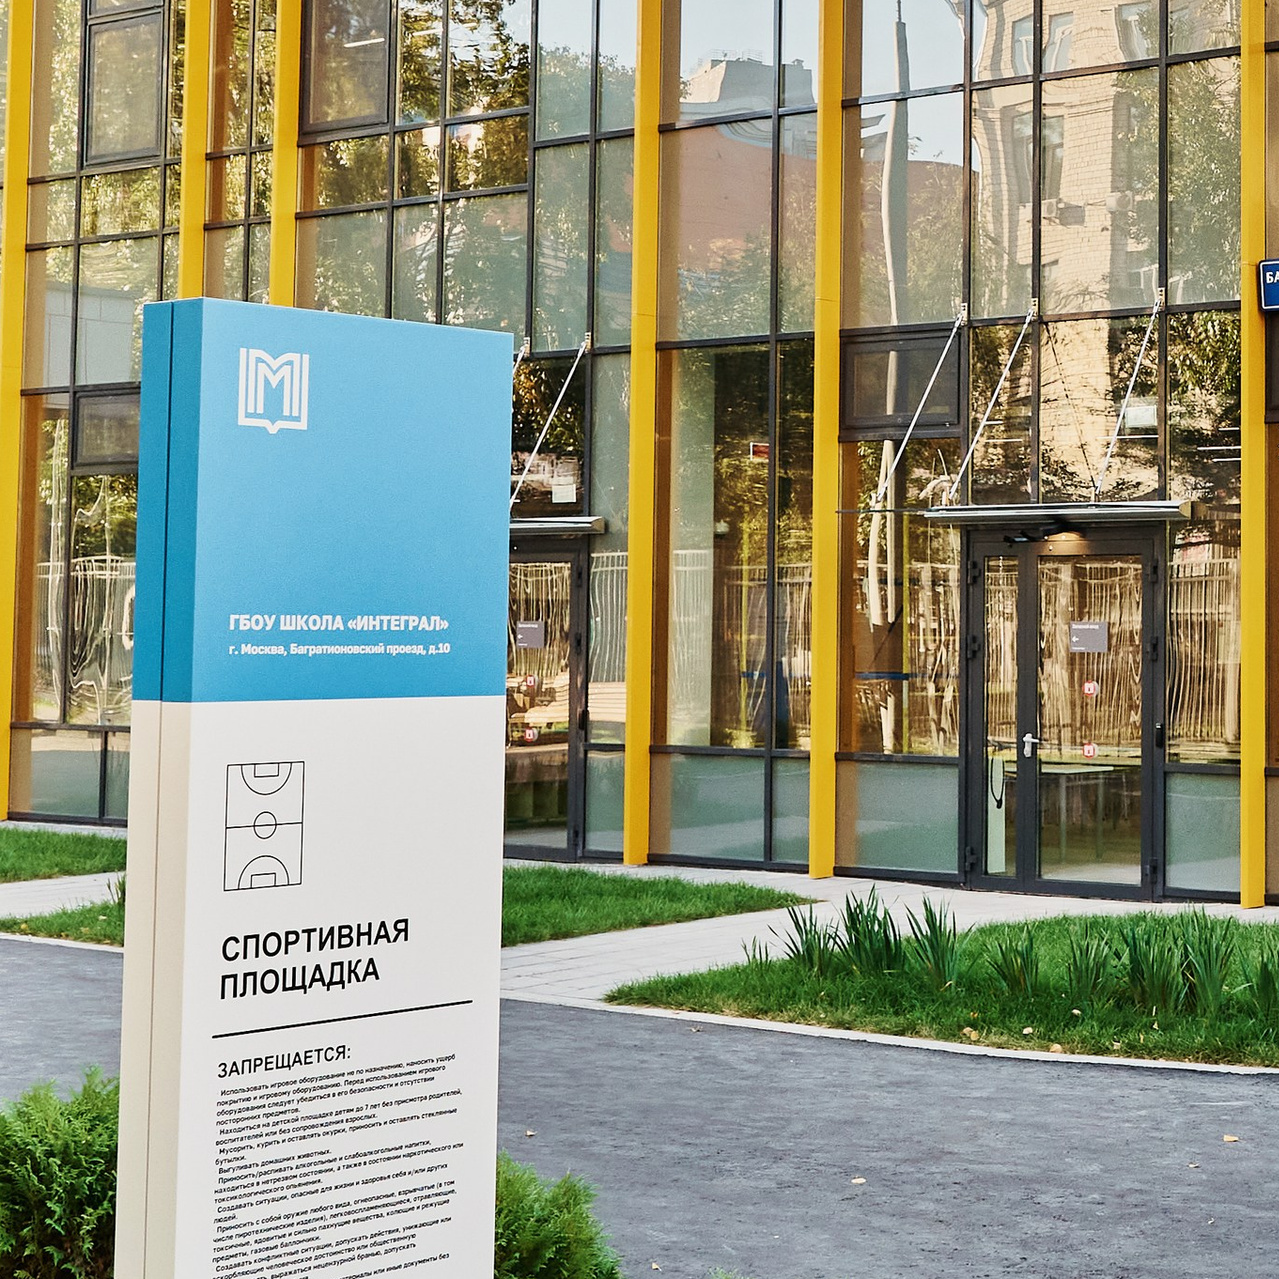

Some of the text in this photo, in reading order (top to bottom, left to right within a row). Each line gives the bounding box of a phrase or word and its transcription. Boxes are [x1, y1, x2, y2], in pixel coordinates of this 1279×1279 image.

[229, 614, 449, 631] ГБОУ ШКОЛА «ИНТЕГРАЛ»
[228, 643, 450, 657] г. Москва, Багратионовский проезд, д.10
[221, 917, 410, 962] СПОРТИВНАЯ
[220, 956, 380, 1000] ПЛОЩАДКА
[217, 1044, 351, 1079] ЗАПРЕЩАЕТСЯ:
[221, 1085, 269, 1096] Использовать
[270, 1080, 297, 1088] игровое
[299, 1072, 345, 1084] оборудование
[436, 1054, 455, 1063] ущерб
[217, 1097, 251, 1106] покрытию
[259, 1091, 291, 1100] игровому
[419, 1066, 445, 1074] игрового
[217, 1104, 266, 1116] оборудования
[268, 1099, 294, 1108] следует
[297, 1093, 330, 1105] убедиться
[349, 1084, 393, 1094] безопасности
[400, 1077, 434, 1086] отсутствии
[216, 1114, 260, 1125] посторонних
[220, 1124, 260, 1135] Находиться
[272, 1116, 299, 1127] детской
[300, 1112, 333, 1121] площадке
[335, 1108, 354, 1116] детям
[394, 1096, 427, 1106] присмотра
[257, 1140, 280, 1148] курить
[287, 1133, 321, 1142] оставлять
[349, 1122, 382, 1132] приносить
[389, 1115, 420, 1124] оставлять
[422, 1108, 457, 1118] стеклянные
[216, 1132, 263, 1146] воспитателей
[214, 1182, 254, 1194] находиться
[262, 1174, 297, 1184] нетрезвом
[368, 1155, 401, 1165] состоянии
[219, 1163, 259, 1174] Выгуливать
[261, 1156, 295, 1167] домашних
[295, 1158, 337, 1169] алкогольные
[218, 1202, 254, 1213] Создавать
[291, 1189, 319, 1198] опасные
[334, 1182, 354, 1190] жизни
[361, 1175, 390, 1185] здоровья
[408, 1168, 425, 1176] и/или
[427, 1164, 447, 1172] других
